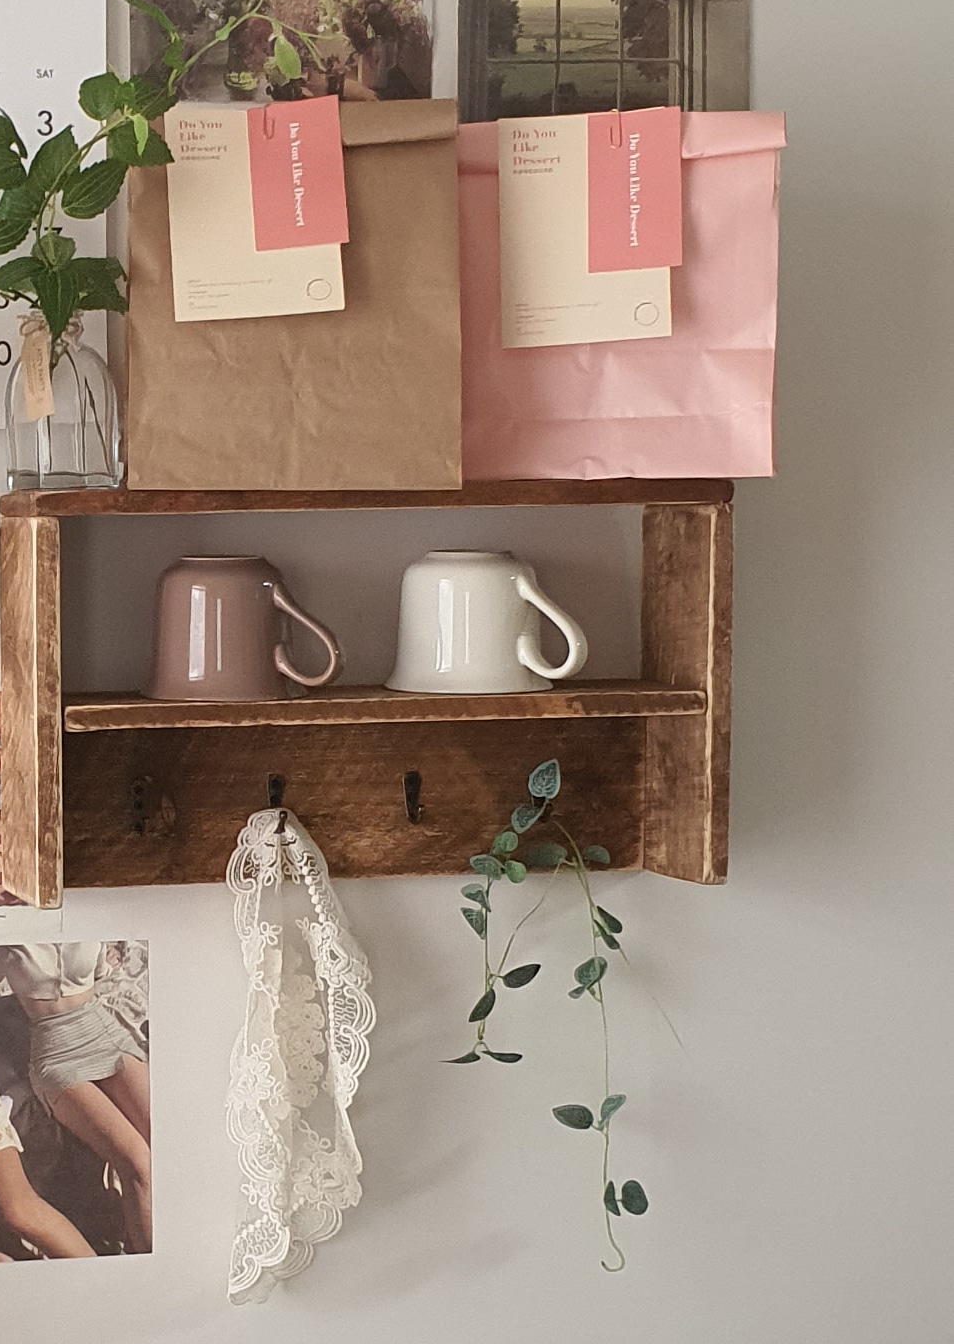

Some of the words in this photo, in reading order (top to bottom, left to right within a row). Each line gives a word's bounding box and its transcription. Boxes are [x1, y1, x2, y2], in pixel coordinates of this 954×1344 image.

[35, 68, 55, 79] SAT
[36, 109, 54, 136] 3
[178, 119, 197, 130] Do
[199, 120, 223, 129] You
[289, 122, 300, 139] Do
[513, 129, 530, 140] Do
[533, 129, 557, 139] You
[629, 133, 640, 150] Do
[290, 139, 301, 161] You
[292, 162, 303, 186] Like
[629, 153, 640, 174] You
[629, 176, 641, 202] Like
[629, 204, 641, 247] Dessert
